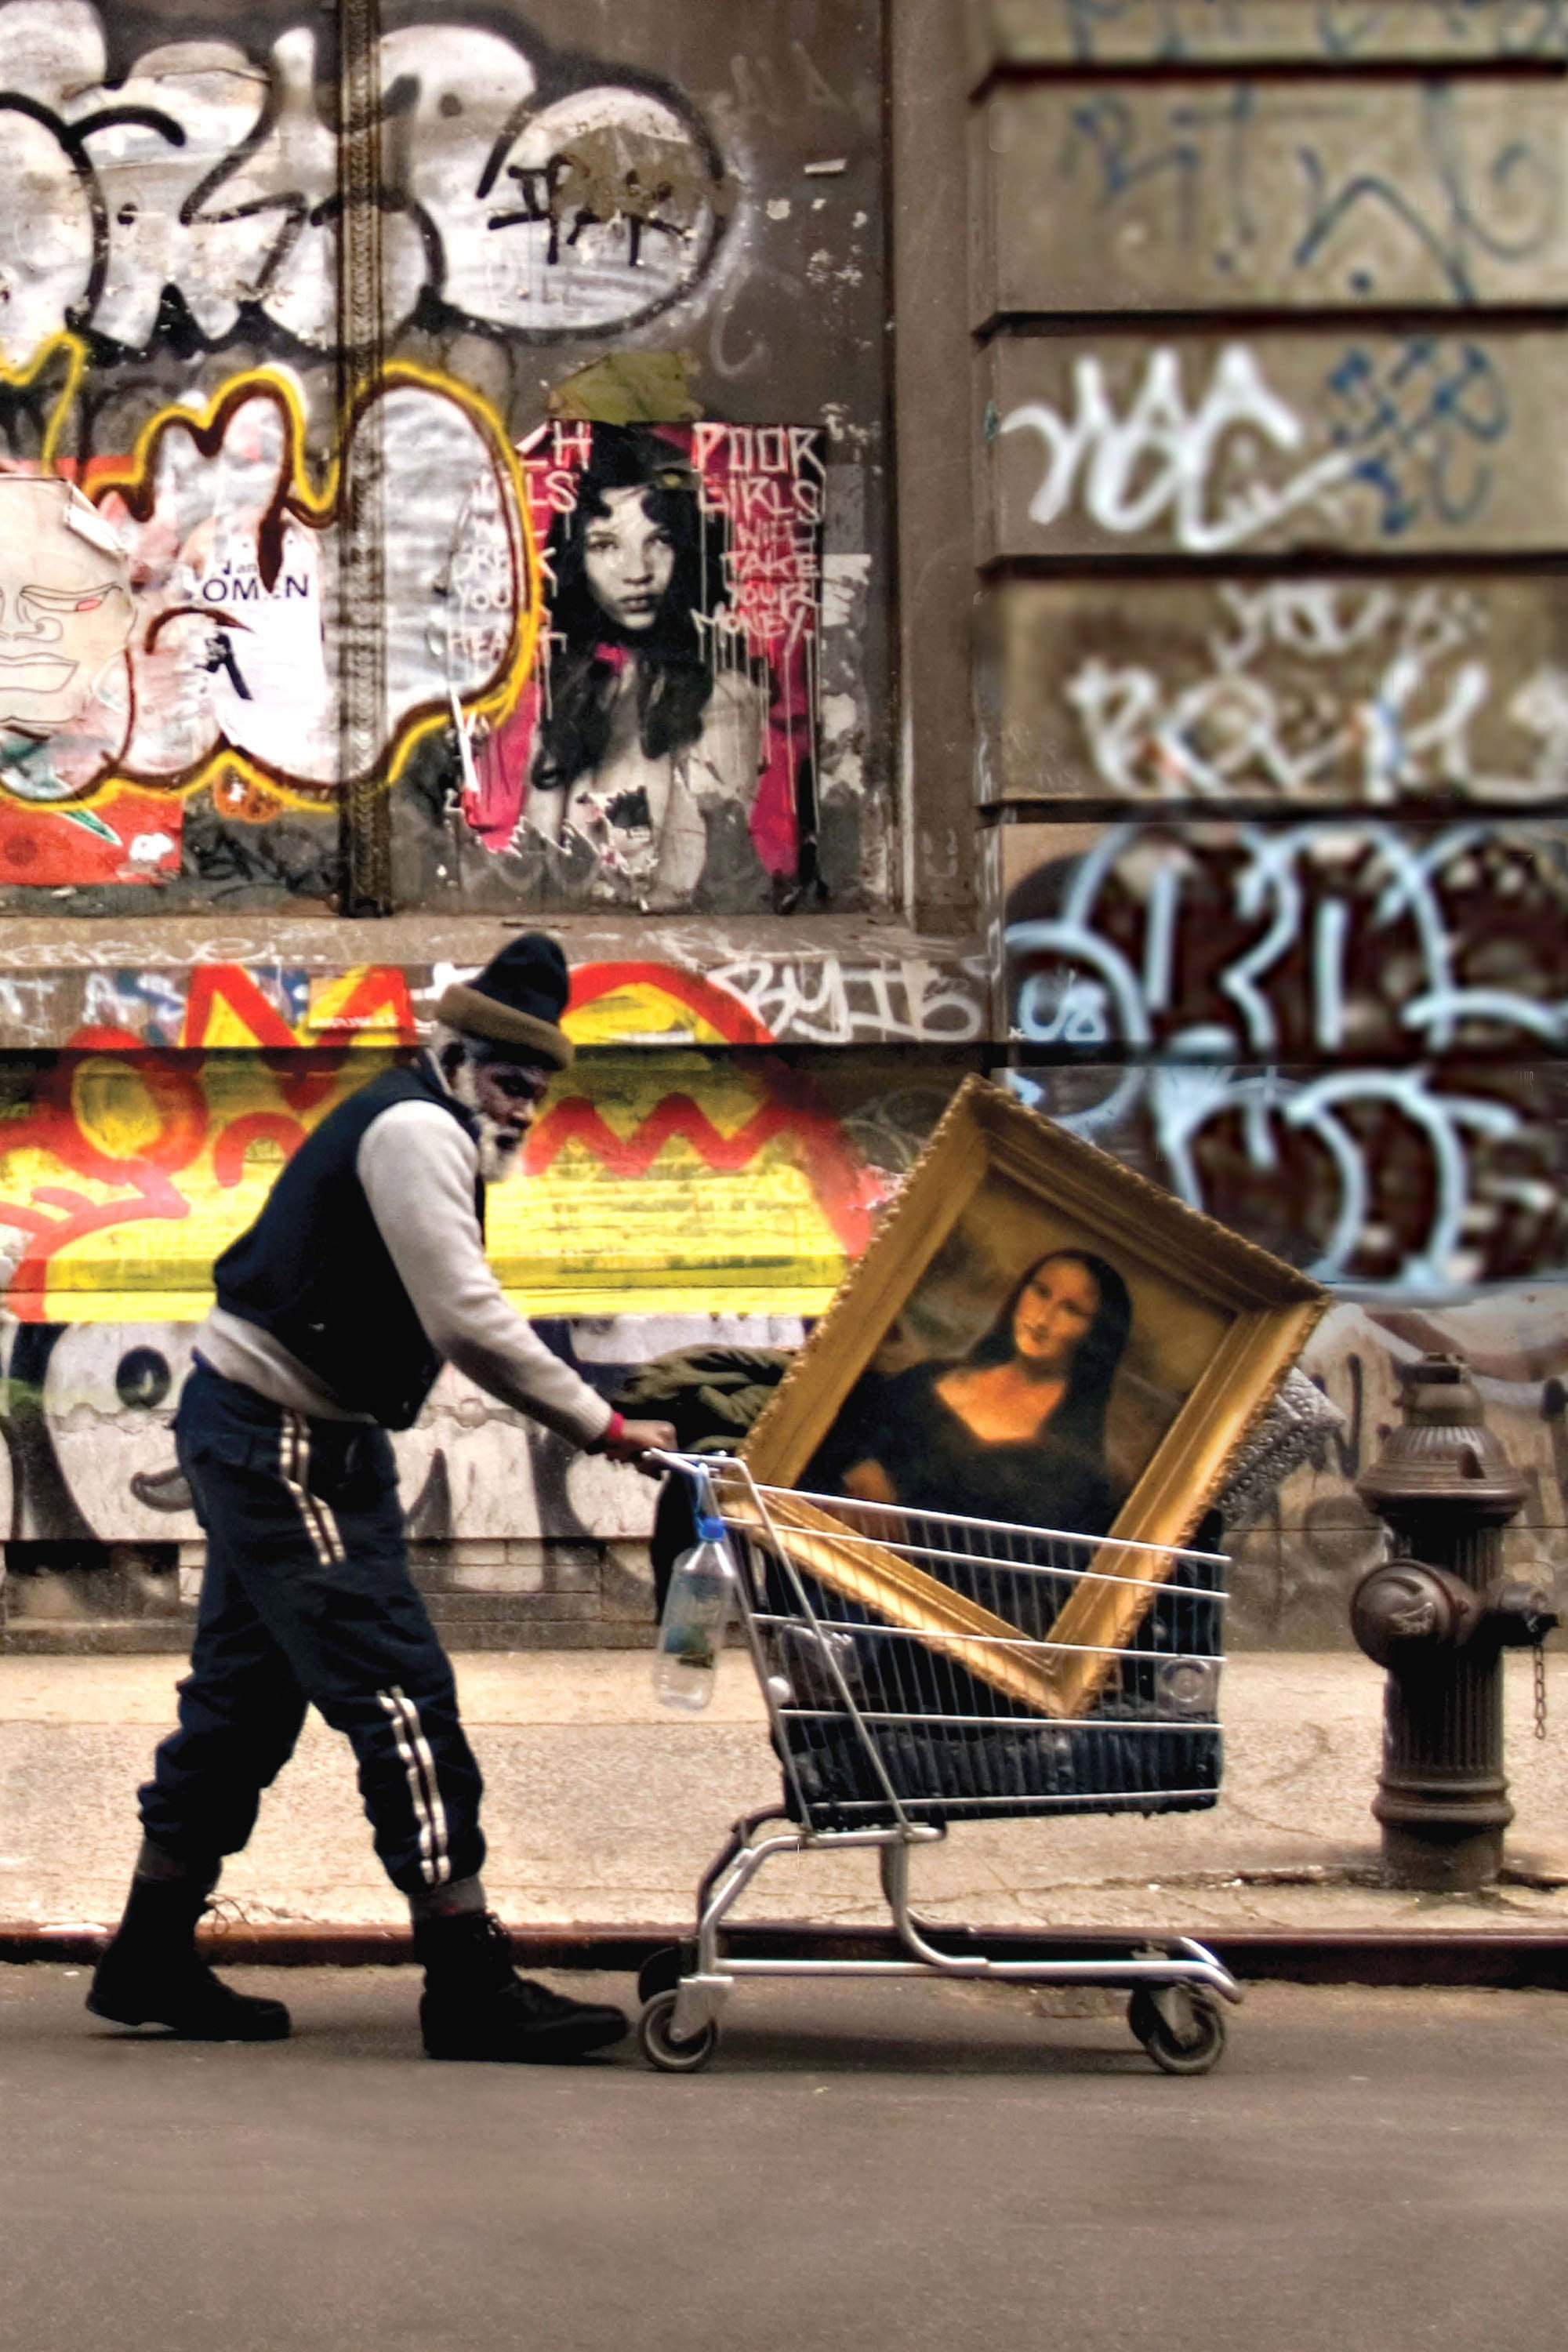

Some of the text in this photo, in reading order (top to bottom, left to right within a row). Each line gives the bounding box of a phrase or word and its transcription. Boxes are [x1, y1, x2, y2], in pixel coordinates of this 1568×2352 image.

[692, 422, 826, 478] POOR
[699, 476, 820, 524] GIRLS
[719, 550, 820, 579] TAKE
[723, 582, 819, 624] YOUR
